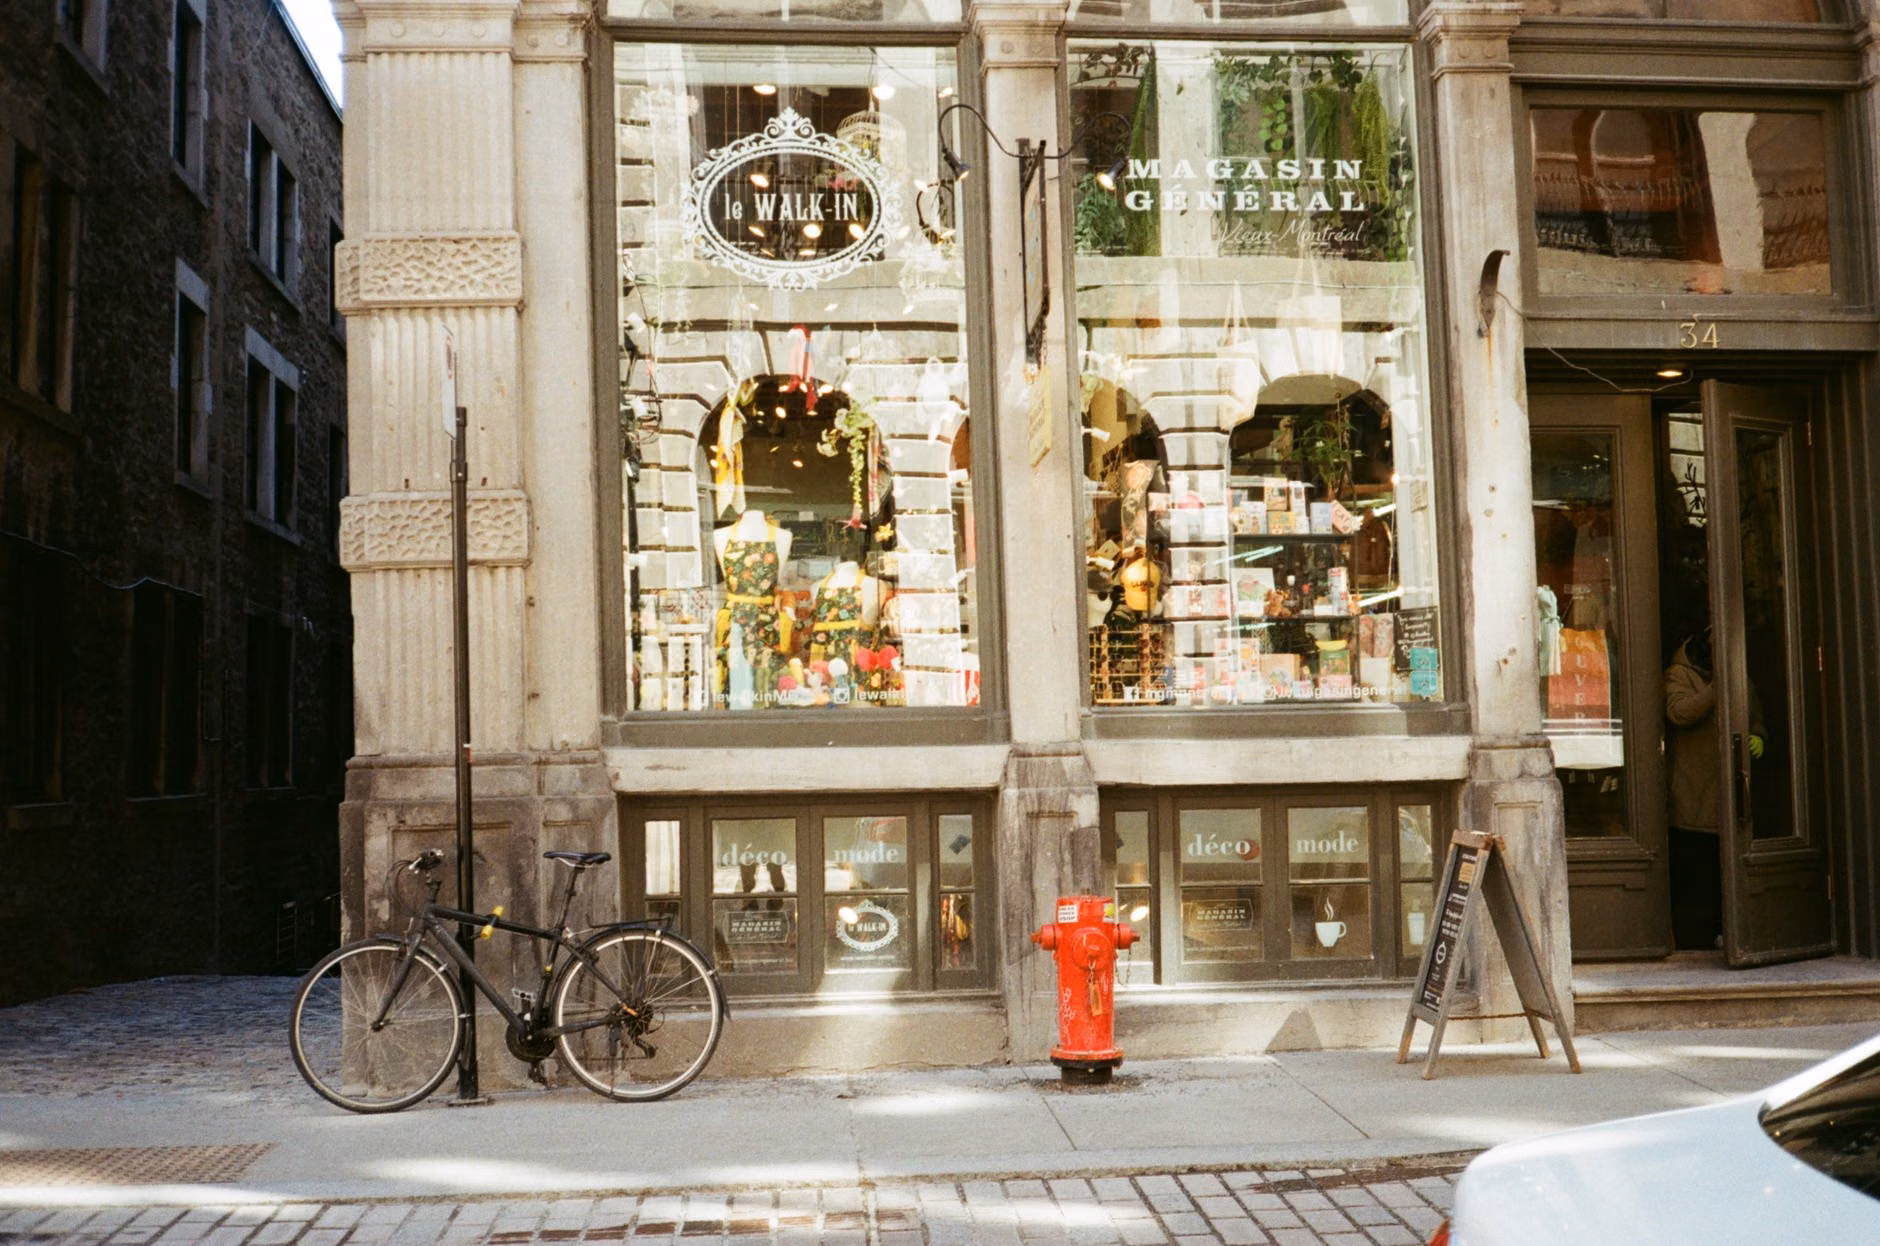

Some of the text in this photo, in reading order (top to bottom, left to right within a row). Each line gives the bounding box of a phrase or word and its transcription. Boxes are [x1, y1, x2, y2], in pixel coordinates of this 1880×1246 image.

[1126, 159, 1363, 179] MAGASIN
[724, 193, 859, 221] le WALK-IN
[1125, 184, 1365, 212] GÉNÉRAL
[1219, 219, 1365, 247] Vieux-Montréal
[1680, 322, 1720, 348] 34
[834, 841, 898, 863] mode
[1188, 833, 1250, 857] déco
[1296, 830, 1359, 853] mode
[722, 842, 787, 866] déco
